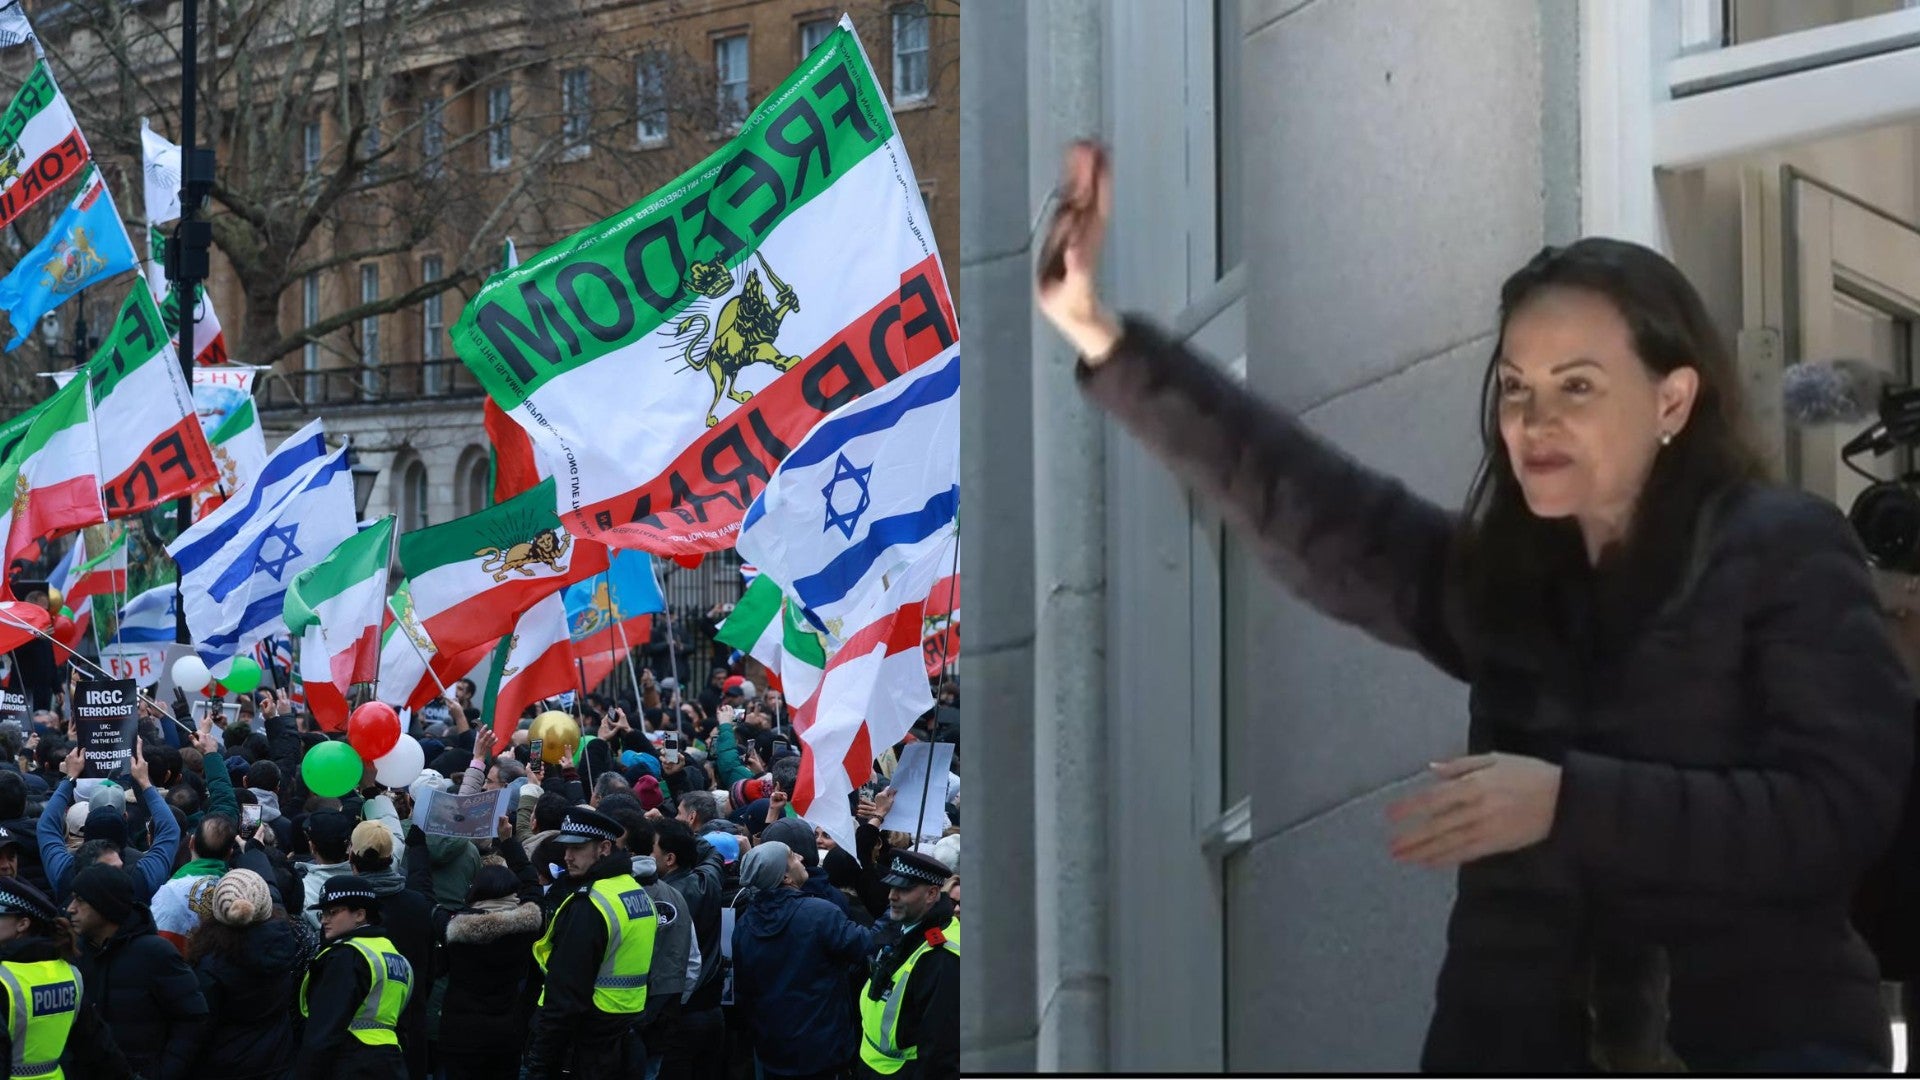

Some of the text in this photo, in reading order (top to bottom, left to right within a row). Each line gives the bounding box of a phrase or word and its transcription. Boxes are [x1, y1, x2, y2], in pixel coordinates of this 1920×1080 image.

[5, 693, 25, 704] RGC
[86, 689, 123, 705] IRGC
[78, 705, 133, 717] TERRORIST
[85, 748, 132, 760] PROSCRIBE
[95, 761, 122, 770] THEM!
[34, 985, 75, 1012] POLICE
